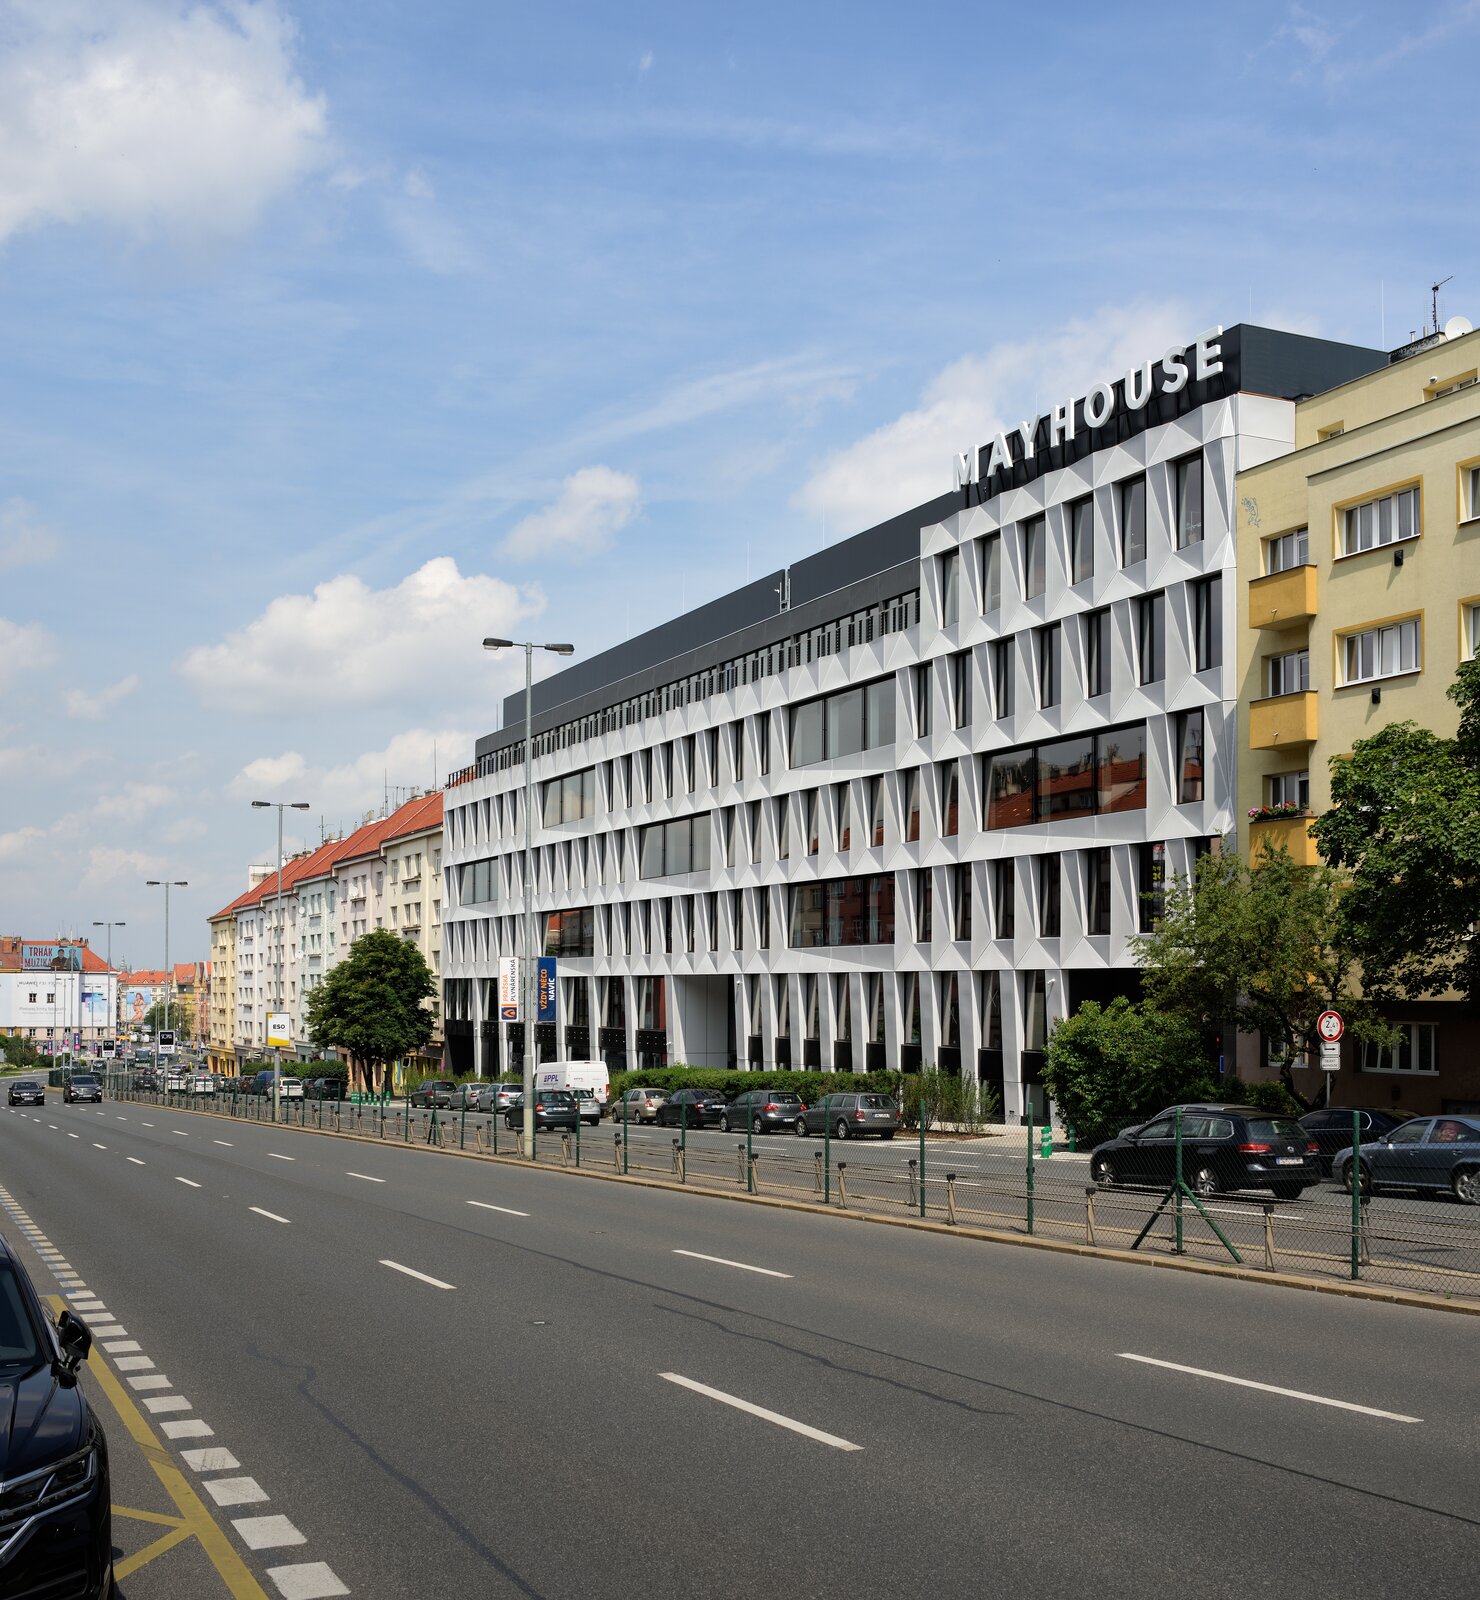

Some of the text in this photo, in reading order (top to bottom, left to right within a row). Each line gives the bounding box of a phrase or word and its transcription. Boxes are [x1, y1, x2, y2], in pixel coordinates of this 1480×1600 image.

[953, 325, 1223, 491] MAYHOUSE
[29, 946, 52, 956] TRHÁK
[547, 978, 555, 1001] NAVÍC
[547, 1074, 559, 1082] PPL
